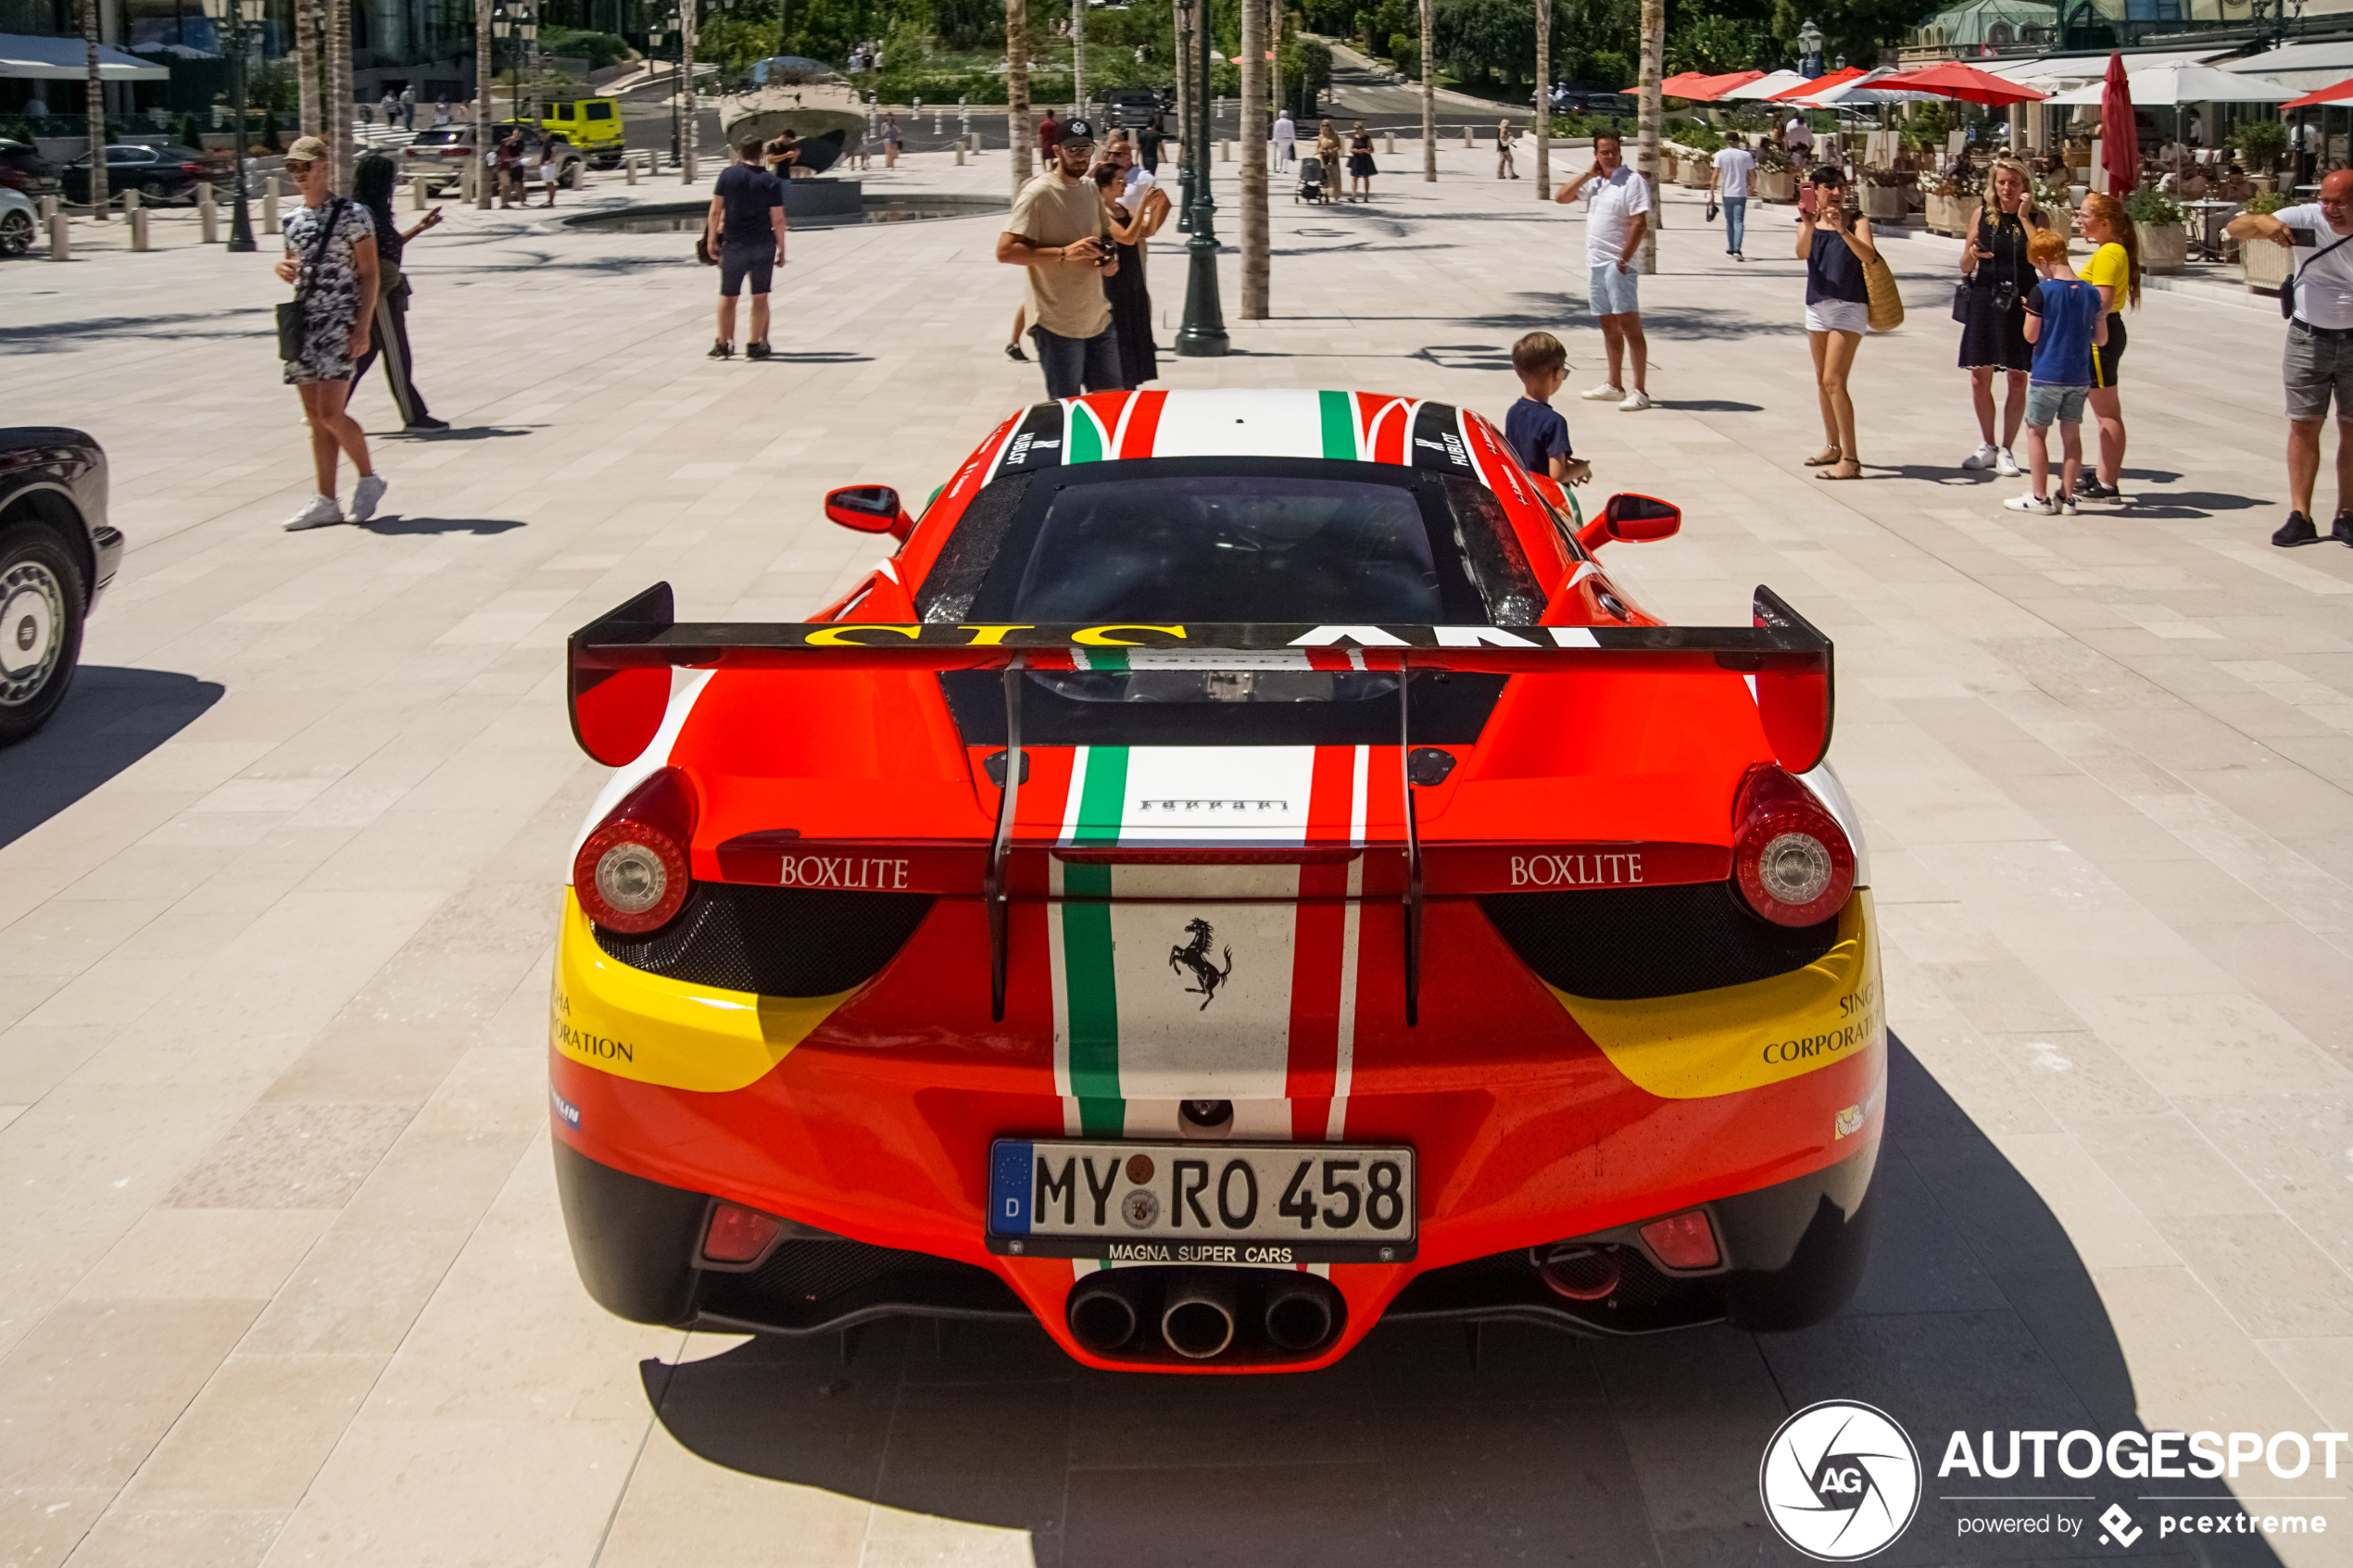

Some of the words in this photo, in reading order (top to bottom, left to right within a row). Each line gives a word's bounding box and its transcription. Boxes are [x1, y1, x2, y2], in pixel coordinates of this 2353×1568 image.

[1006, 432, 1036, 465] HUBLOT
[1441, 432, 1470, 467] HUBLOT
[1139, 799, 1289, 812] Ferrari
[779, 855, 909, 889] BOXLITE
[1511, 853, 1643, 885] BOXLITE
[554, 1017, 634, 1063] ORATION
[1005, 1198, 1019, 1217] D
[1035, 1157, 1122, 1226] MY
[1172, 1160, 1258, 1230] RO
[1279, 1161, 1403, 1231] 458
[1109, 1244, 1170, 1261] MAGNA
[1177, 1246, 1237, 1261] SUPER
[1244, 1247, 1292, 1262] CARS
